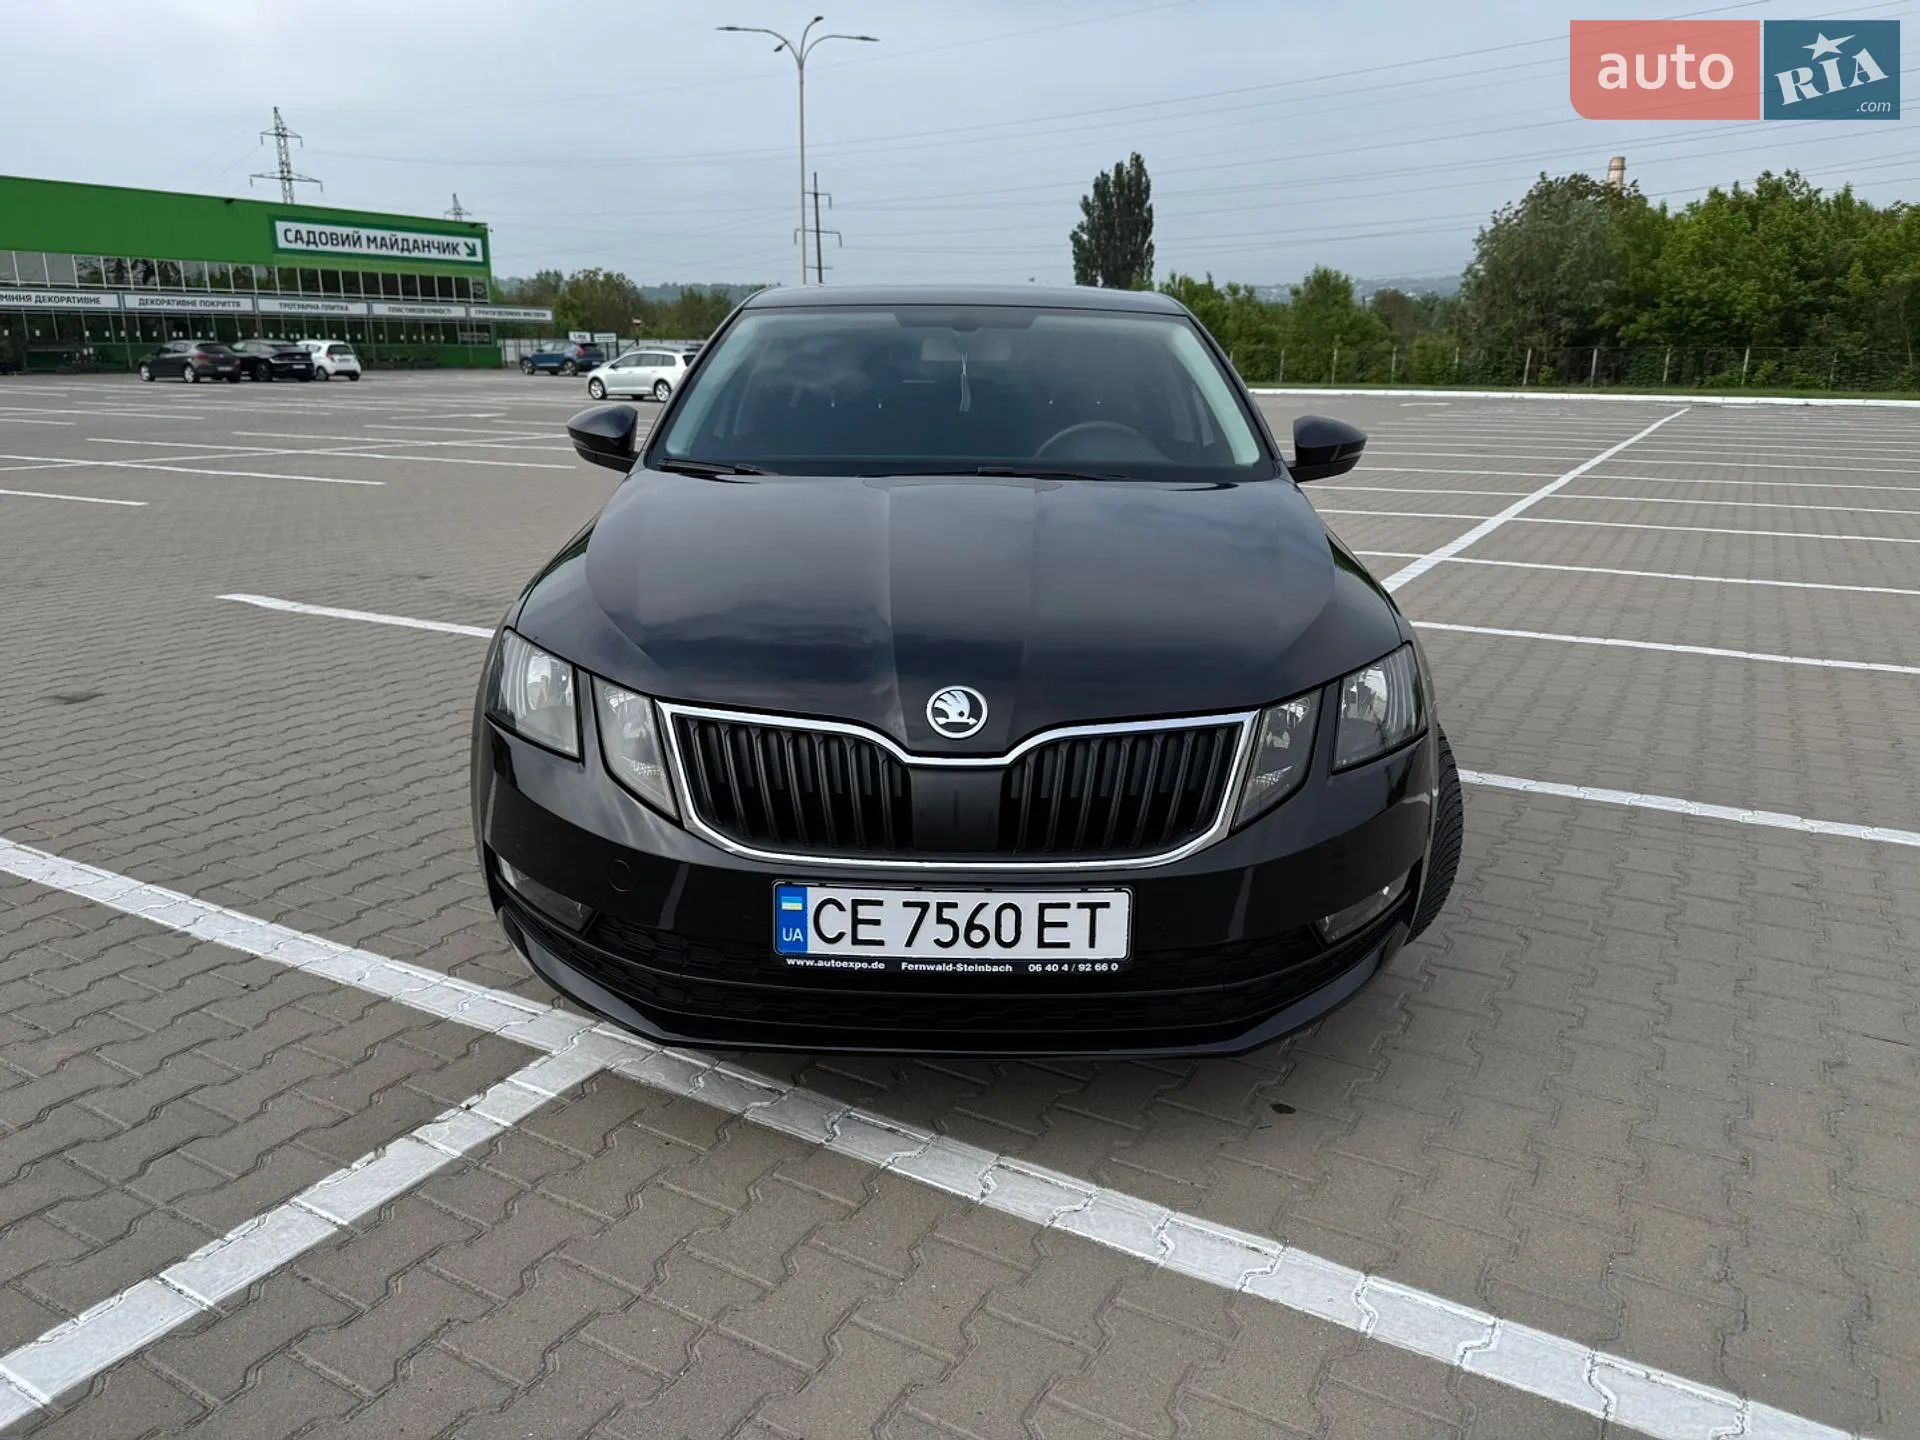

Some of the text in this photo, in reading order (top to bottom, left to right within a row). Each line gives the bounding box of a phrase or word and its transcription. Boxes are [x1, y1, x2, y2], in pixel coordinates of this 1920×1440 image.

[283, 228, 460, 256] САДОВИЙ МАЙДАНЧИК
[34, 294, 101, 305] ДЕКОРАТИВНЕ
[138, 297, 198, 308] ДЕКОРАТИВНЕ
[812, 897, 1111, 950] CE 7560 ET
[782, 927, 804, 943] UA
[786, 957, 886, 970] www.autoexpo.de
[901, 961, 1013, 973] Fernwald-Steinbach
